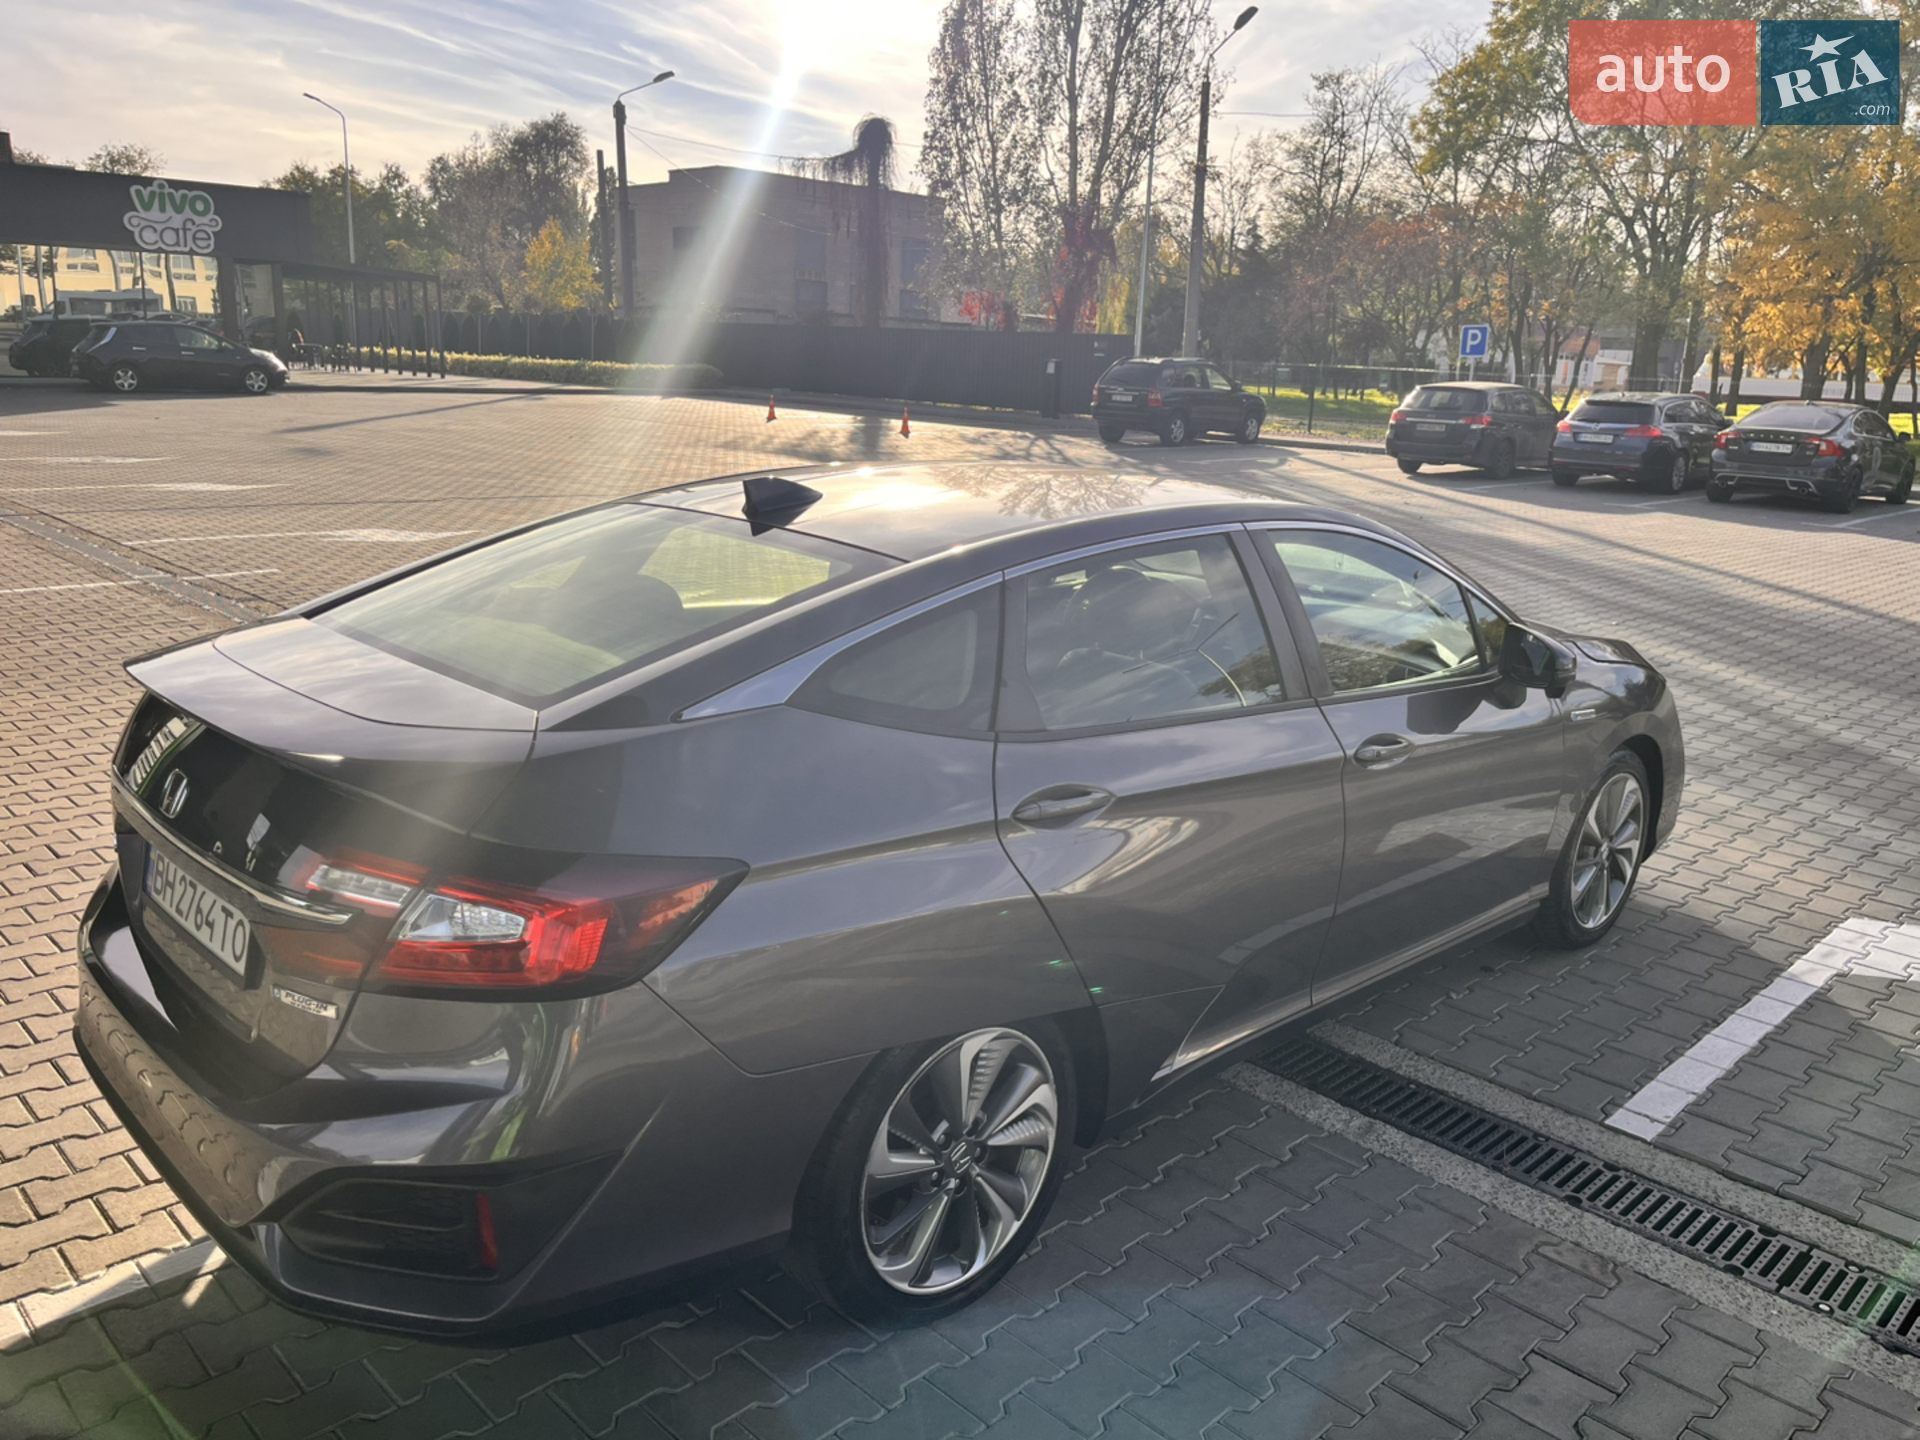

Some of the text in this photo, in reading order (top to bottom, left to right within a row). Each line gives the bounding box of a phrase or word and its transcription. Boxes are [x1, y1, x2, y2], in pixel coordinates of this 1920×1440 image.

[134, 182, 212, 217] vivo
[1466, 329, 1482, 353] P
[153, 852, 246, 963] BH2764TO
[284, 991, 328, 1011] PLUG-IN
